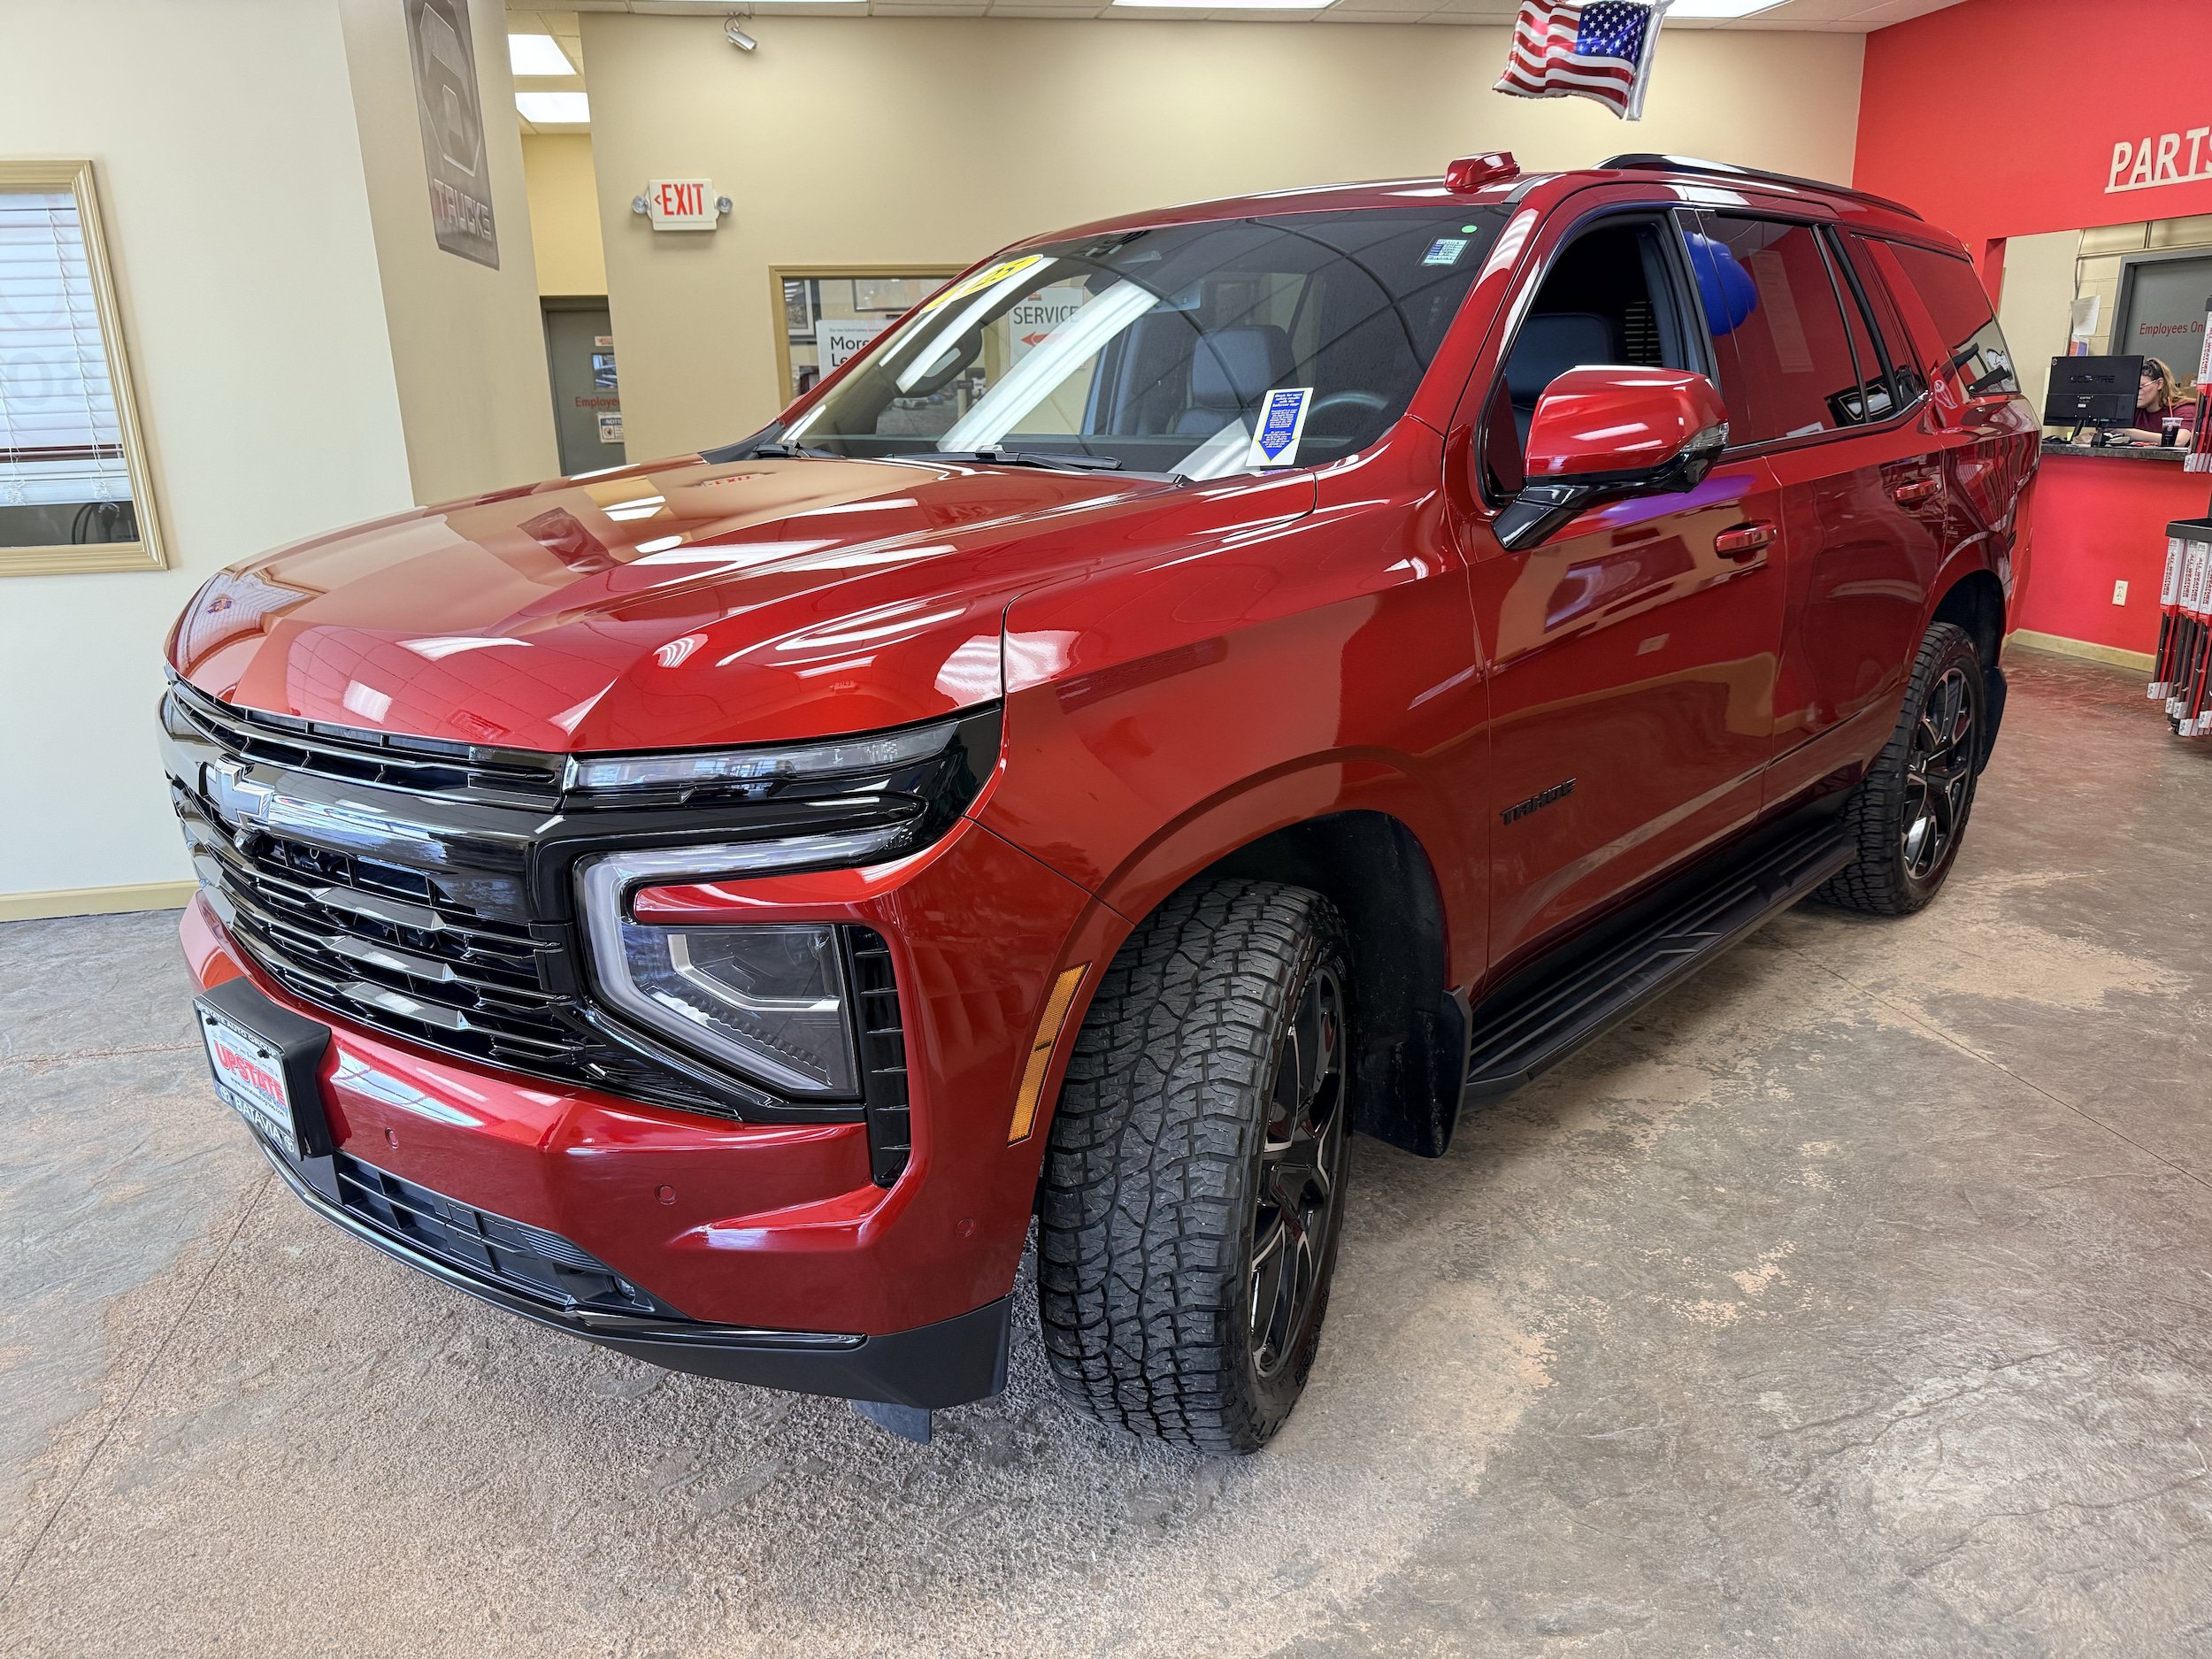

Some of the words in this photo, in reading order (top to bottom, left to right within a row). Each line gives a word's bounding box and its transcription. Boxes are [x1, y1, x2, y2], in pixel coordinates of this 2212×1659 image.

[661, 183, 704, 215] EXIT
[433, 178, 493, 242] TRUCKS
[1013, 305, 1080, 325] SERVICE
[2139, 321, 2187, 337] Employees
[2191, 319, 2208, 333] Onl
[830, 336, 870, 350] More
[832, 353, 849, 367] Le
[574, 396, 620, 411] Employe
[1499, 777, 1578, 826] TAHOE
[229, 1022, 248, 1039] AUTO
[213, 1039, 286, 1108] UPSTATE
[234, 1098, 283, 1144] BATAVIA
